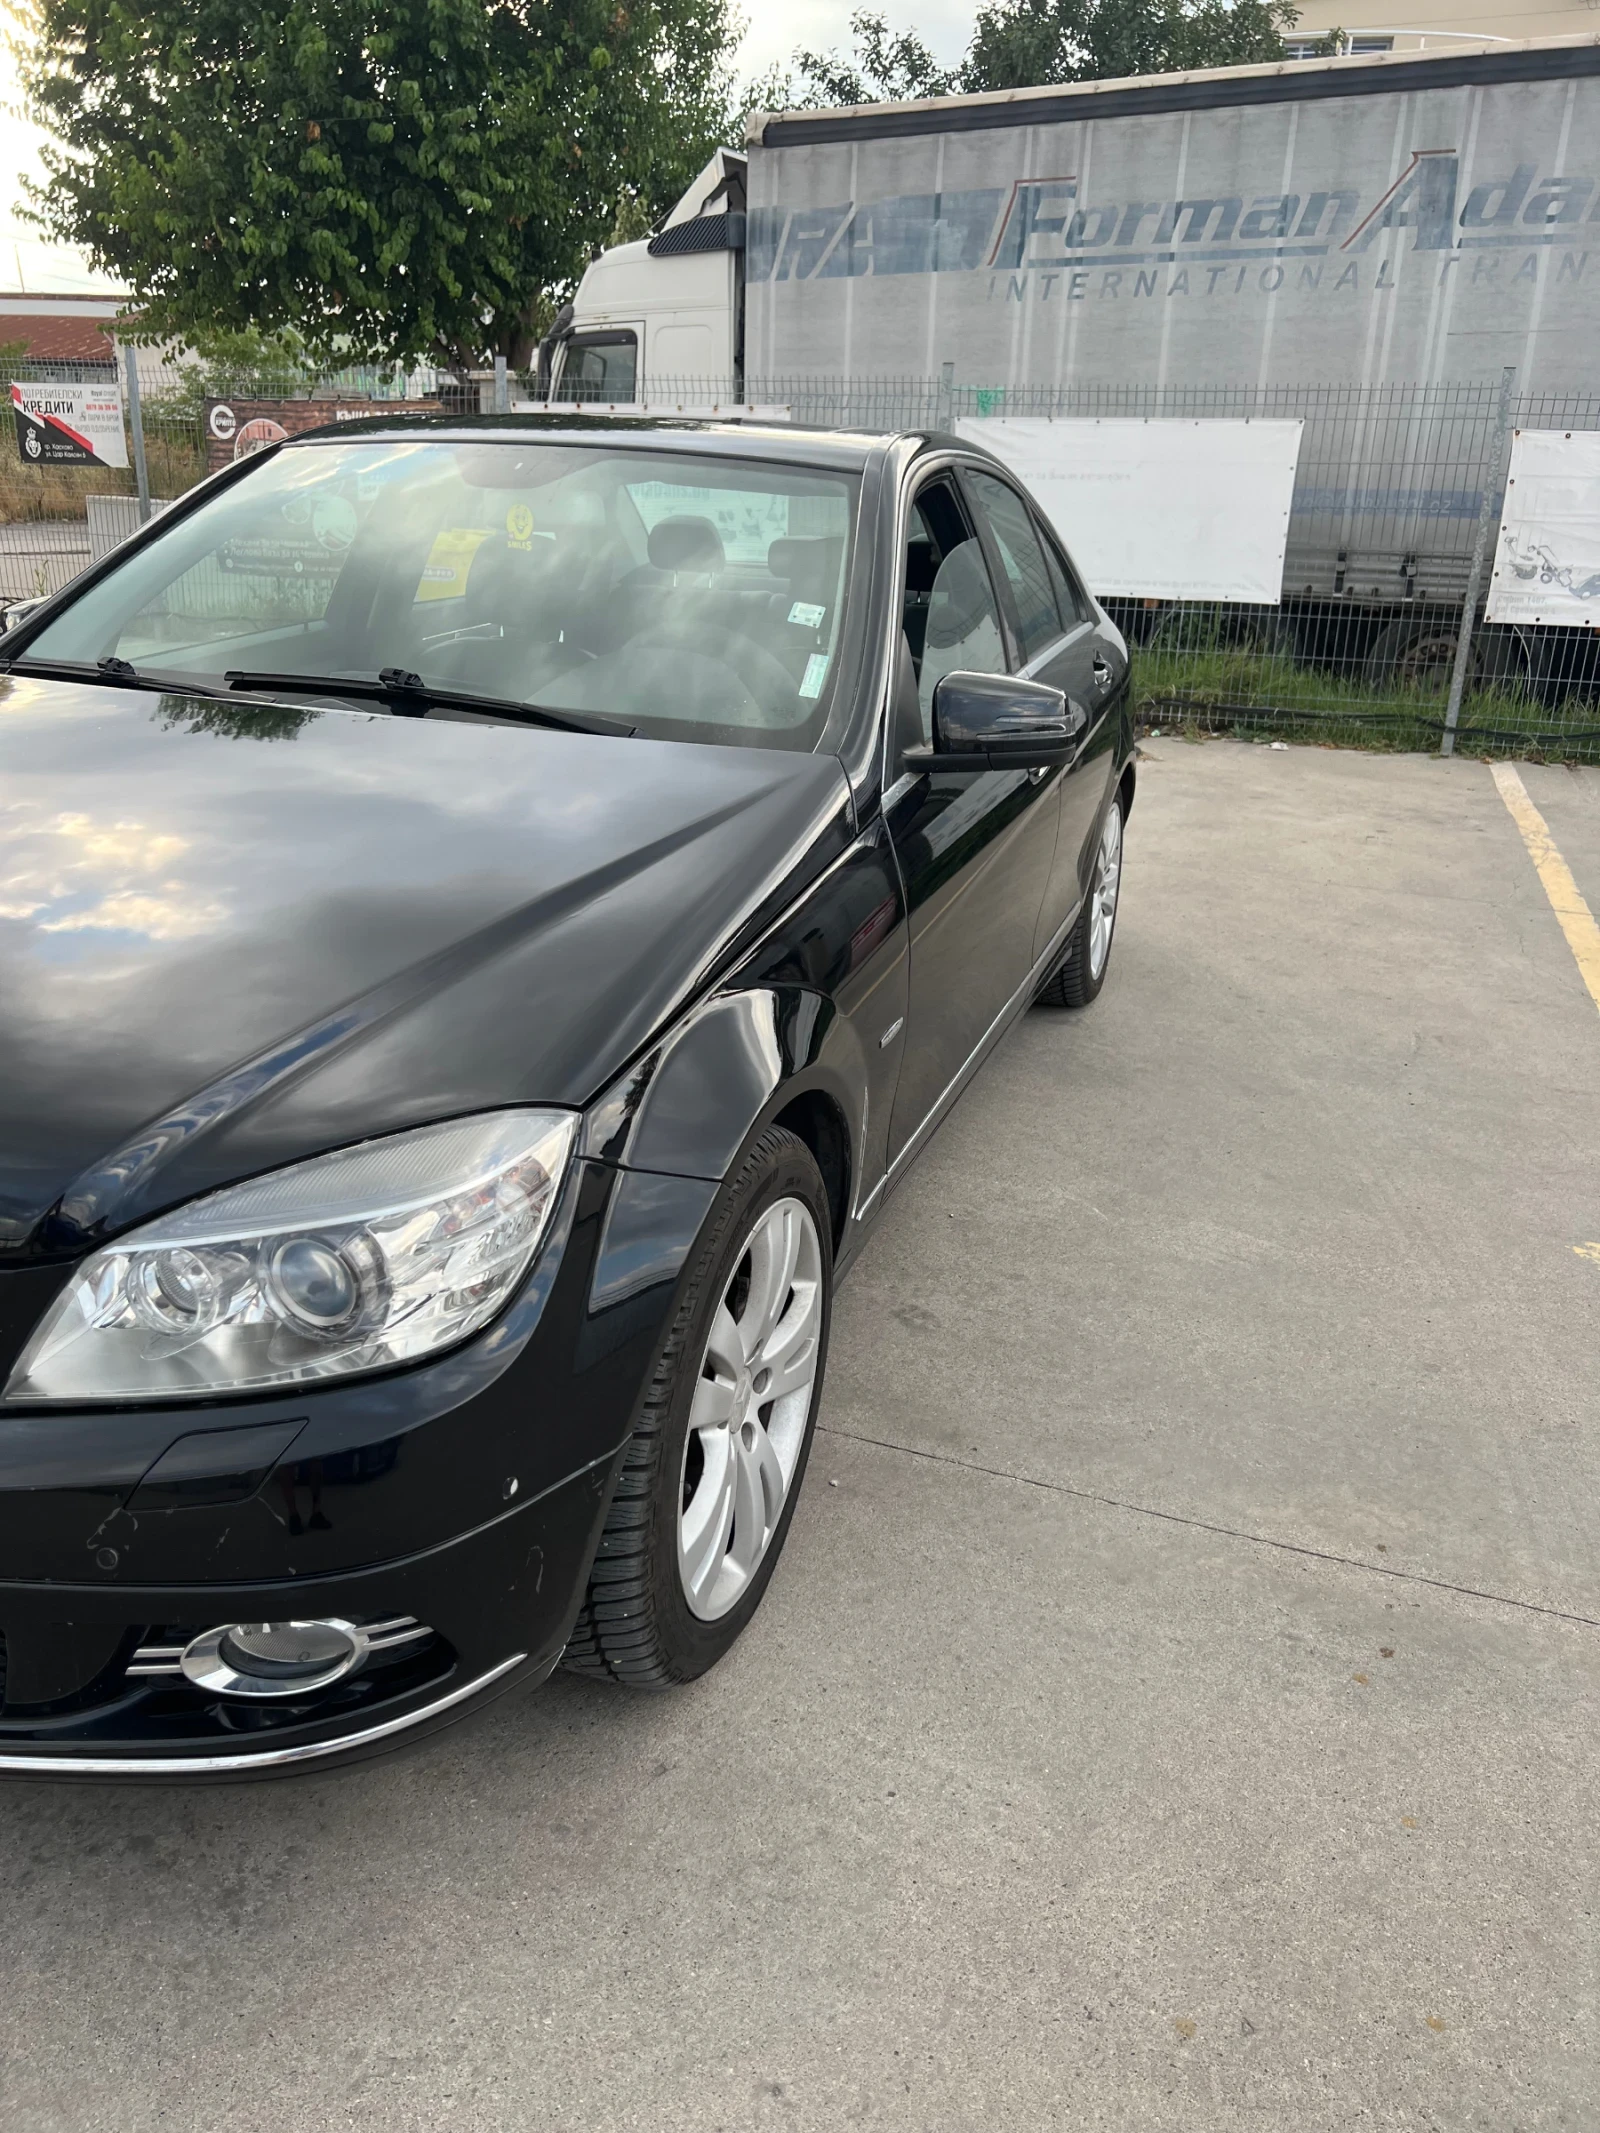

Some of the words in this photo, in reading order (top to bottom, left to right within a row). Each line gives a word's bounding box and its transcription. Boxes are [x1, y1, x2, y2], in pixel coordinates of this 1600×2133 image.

[990, 178, 1360, 269] Forman
[1343, 153, 1600, 252] Ada
[987, 259, 1395, 301] INTERNATIONAL
[22, 388, 83, 400] ПОТРЕБИТЕЛСКИ
[22, 400, 74, 415] КРЕДИТИ
